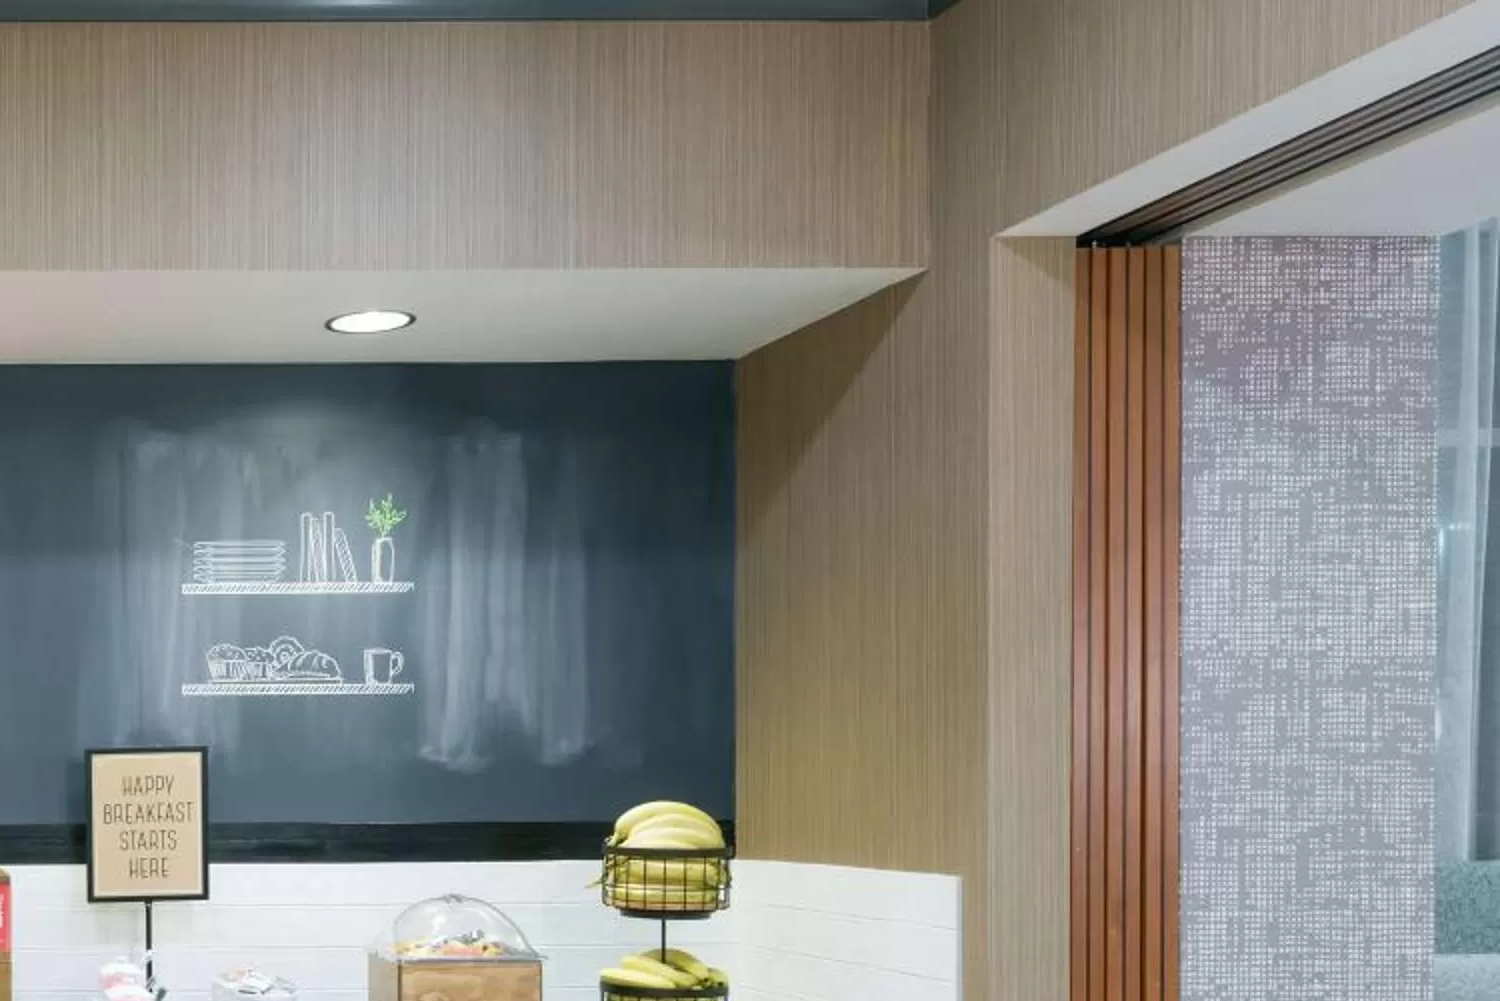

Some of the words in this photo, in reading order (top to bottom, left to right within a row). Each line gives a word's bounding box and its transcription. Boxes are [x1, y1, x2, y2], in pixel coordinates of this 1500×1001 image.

[121, 775, 175, 797] HAPPY
[102, 801, 195, 825] BREAKFAST
[119, 829, 178, 851] STARTS
[128, 856, 171, 879] HERE
